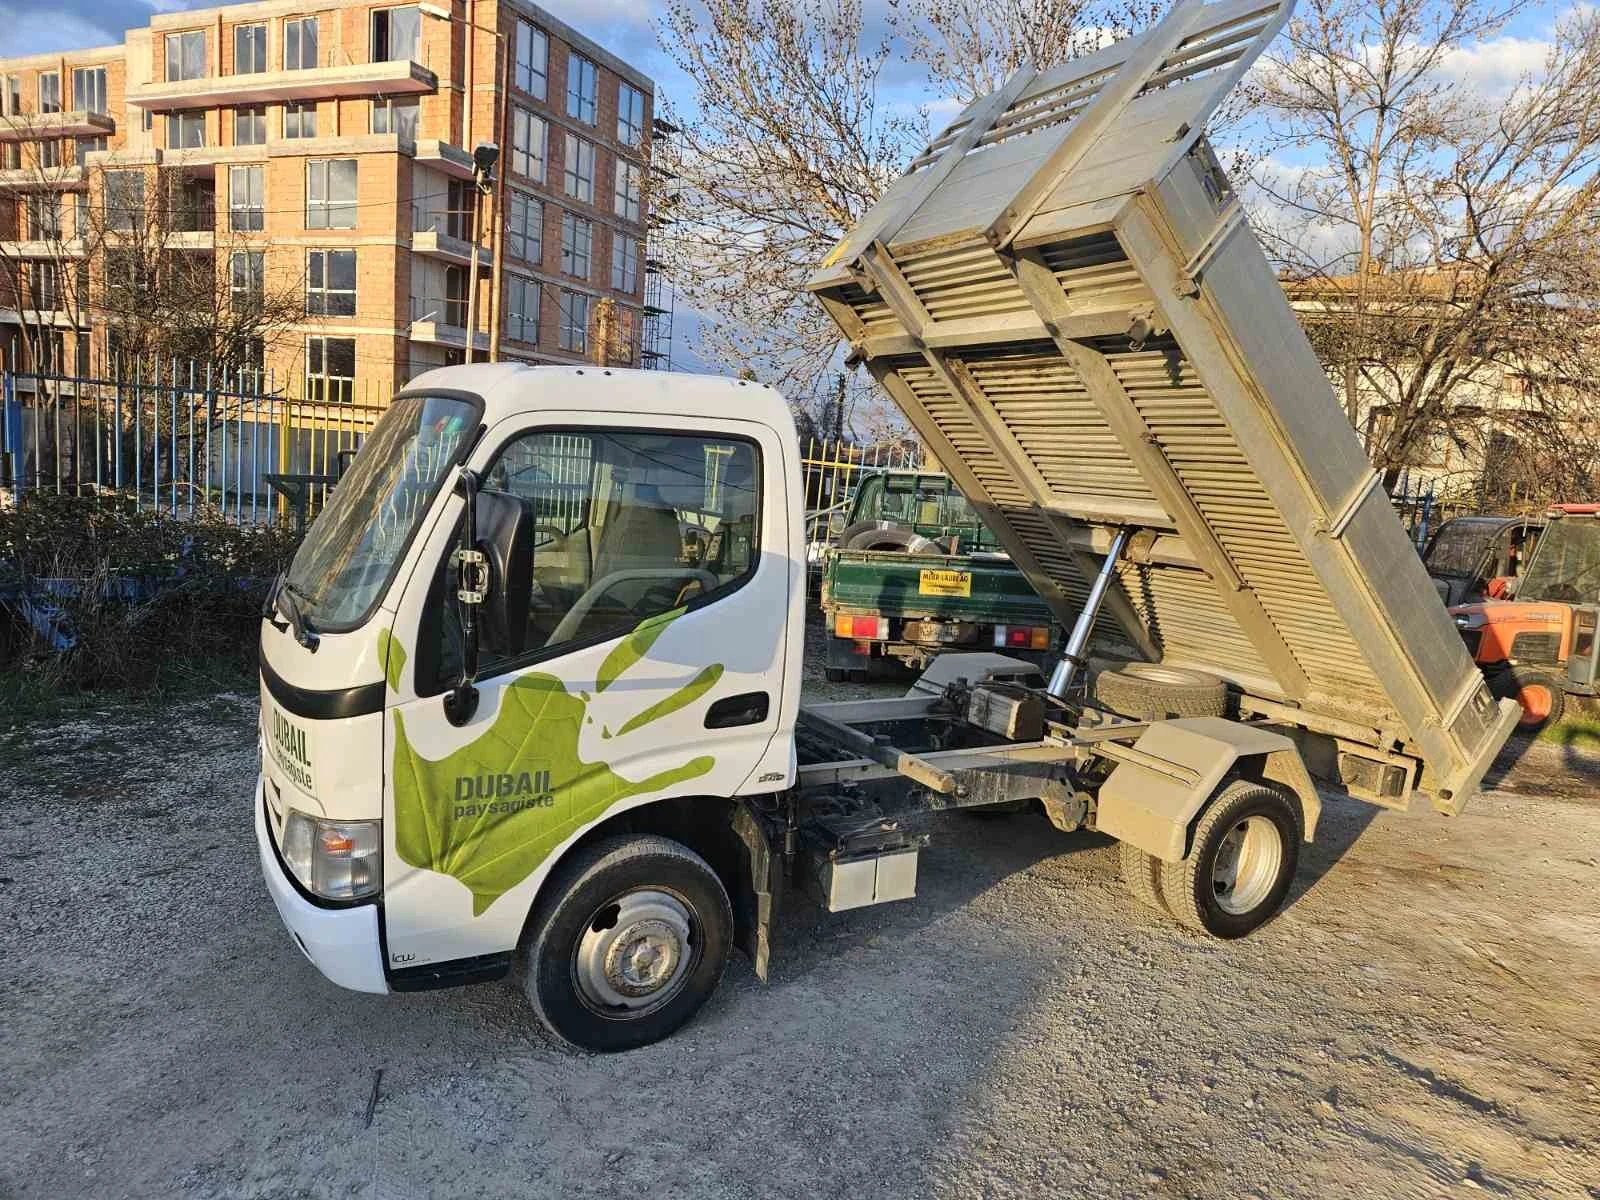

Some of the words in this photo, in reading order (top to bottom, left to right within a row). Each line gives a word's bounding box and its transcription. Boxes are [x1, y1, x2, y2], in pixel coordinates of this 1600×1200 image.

[273, 707, 311, 767] DUBAIL
[455, 770, 553, 801] DUBAIL
[454, 795, 554, 820] paysagiste
